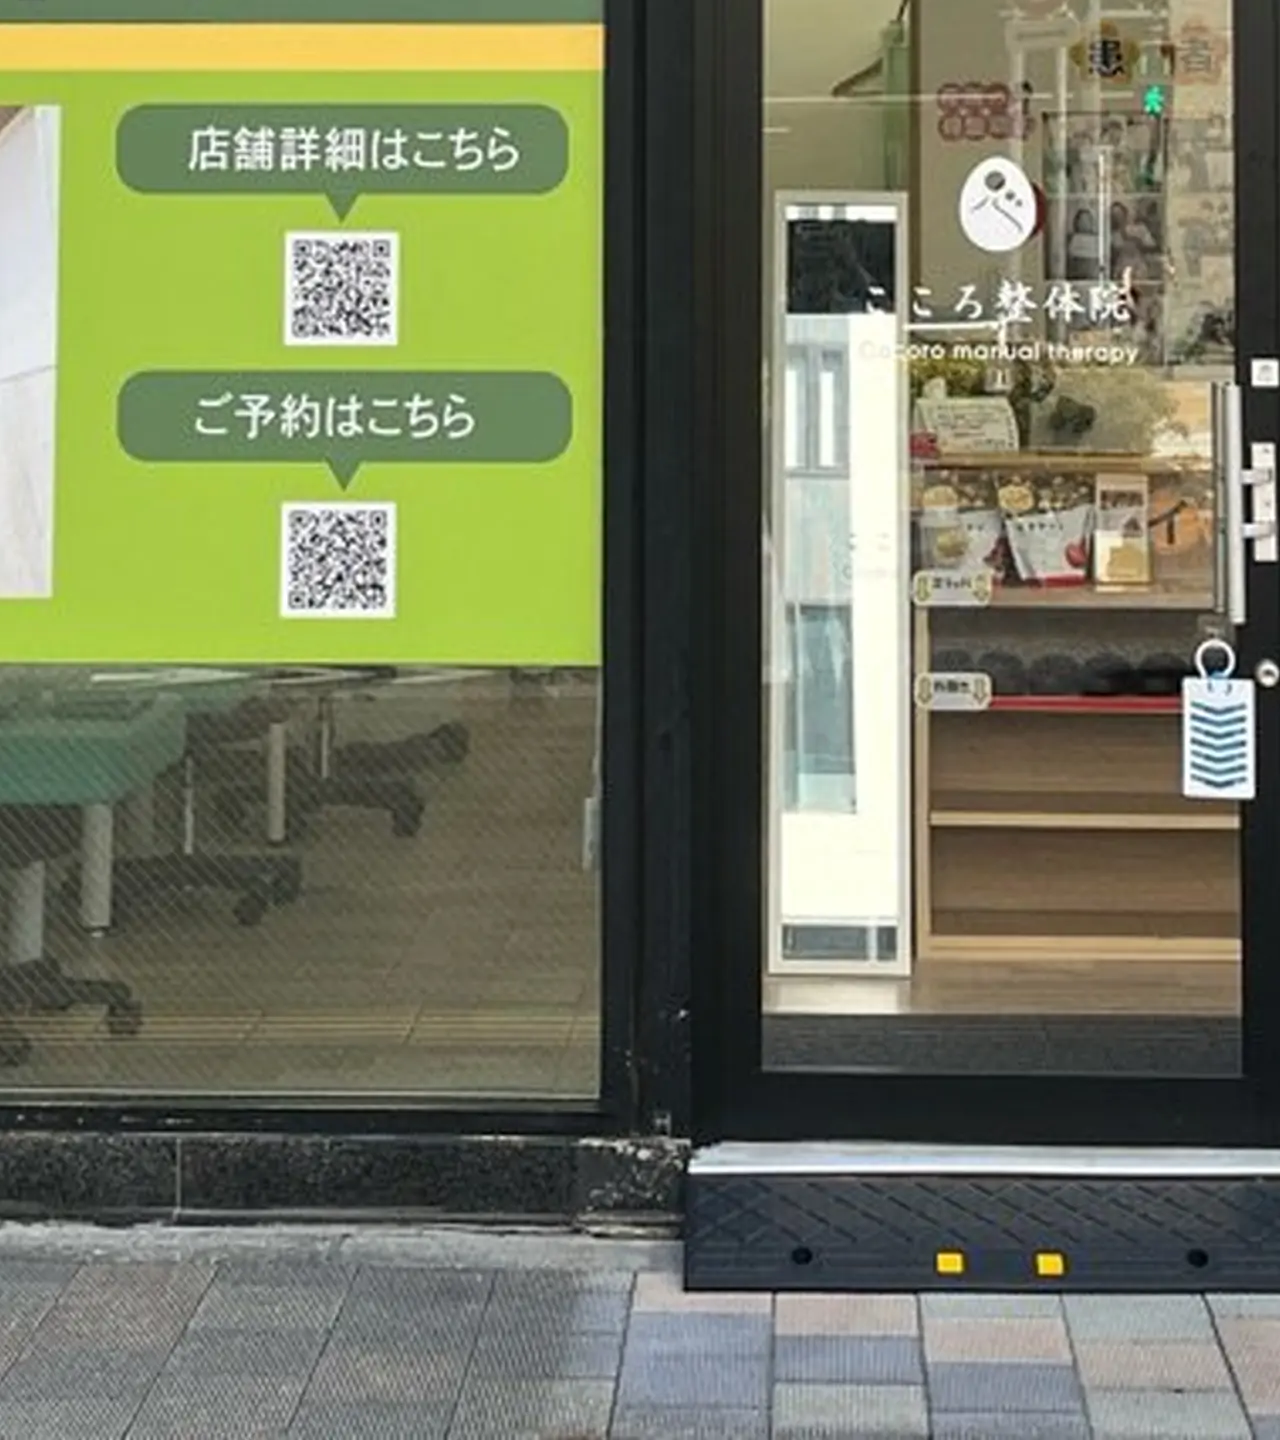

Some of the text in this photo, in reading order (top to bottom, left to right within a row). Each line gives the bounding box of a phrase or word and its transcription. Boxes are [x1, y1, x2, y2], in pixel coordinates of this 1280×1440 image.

[187, 125, 520, 173] 店舗詳細はこちら
[866, 279, 1131, 322] こころ整体院
[952, 340, 1041, 361] manual
[1047, 340, 1139, 366] therapy
[194, 391, 476, 440] ご予約はこちら
